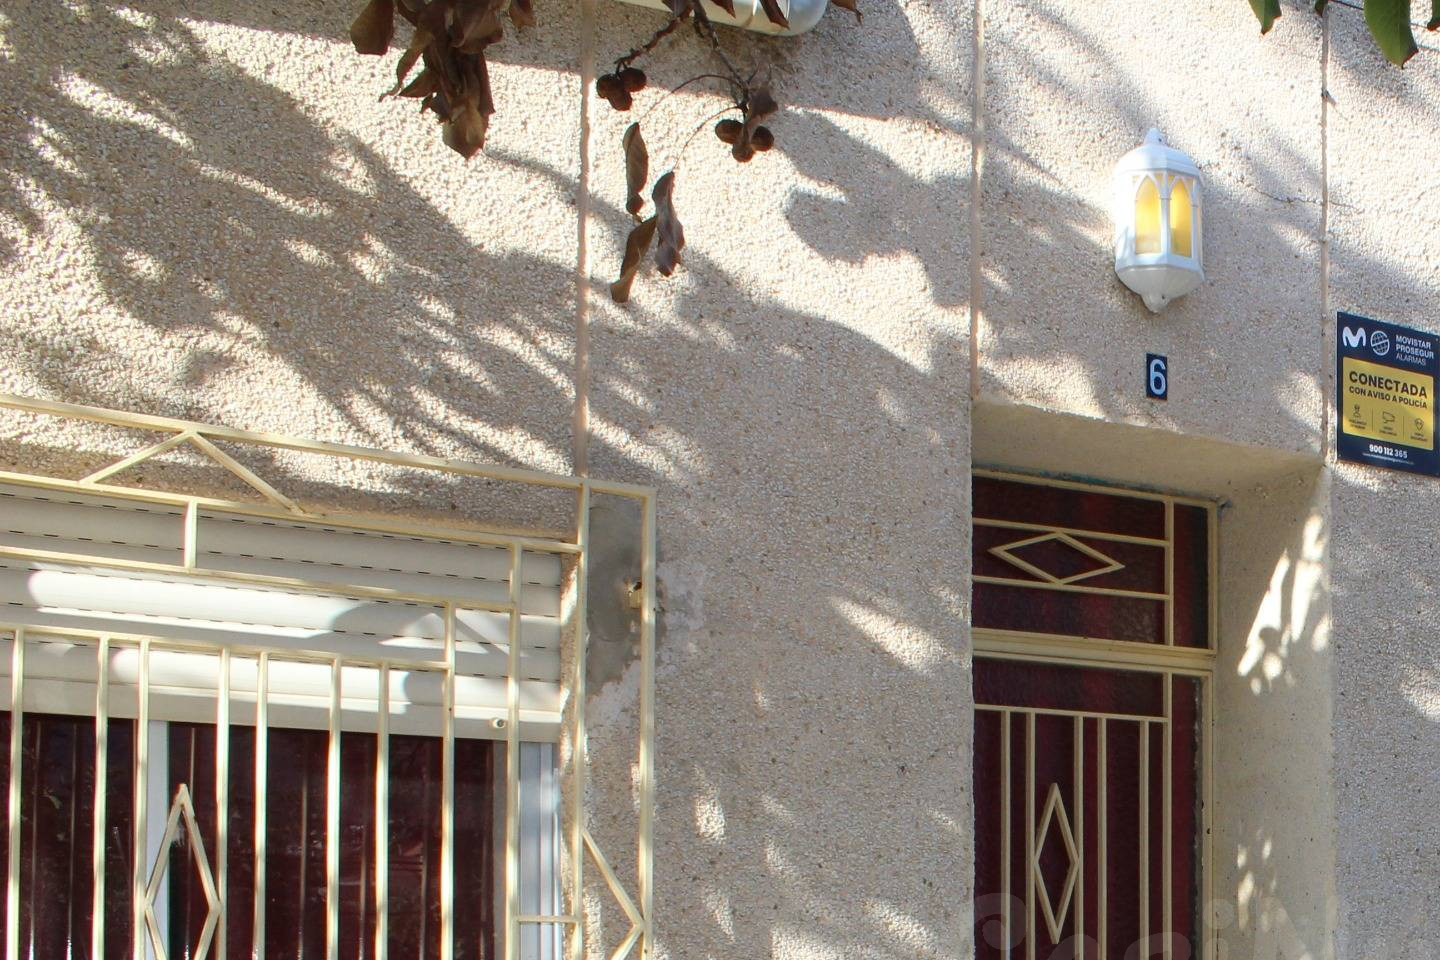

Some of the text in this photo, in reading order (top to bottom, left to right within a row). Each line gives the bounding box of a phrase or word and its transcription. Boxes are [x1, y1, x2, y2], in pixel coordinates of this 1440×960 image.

[1395, 334, 1431, 350] MOVISTAR
[1395, 343, 1434, 359] PROSEGUR
[1395, 353, 1427, 366] ALARMAS
[1150, 358, 1166, 396] 6
[1349, 370, 1428, 399] CONECTADA
[1349, 386, 1366, 396] CON
[1367, 389, 1391, 401] AVISO
[1398, 396, 1428, 409] POLICÍA
[1369, 444, 1383, 454] 900
[1383, 446, 1394, 456] 112
[1394, 449, 1408, 459] 365
